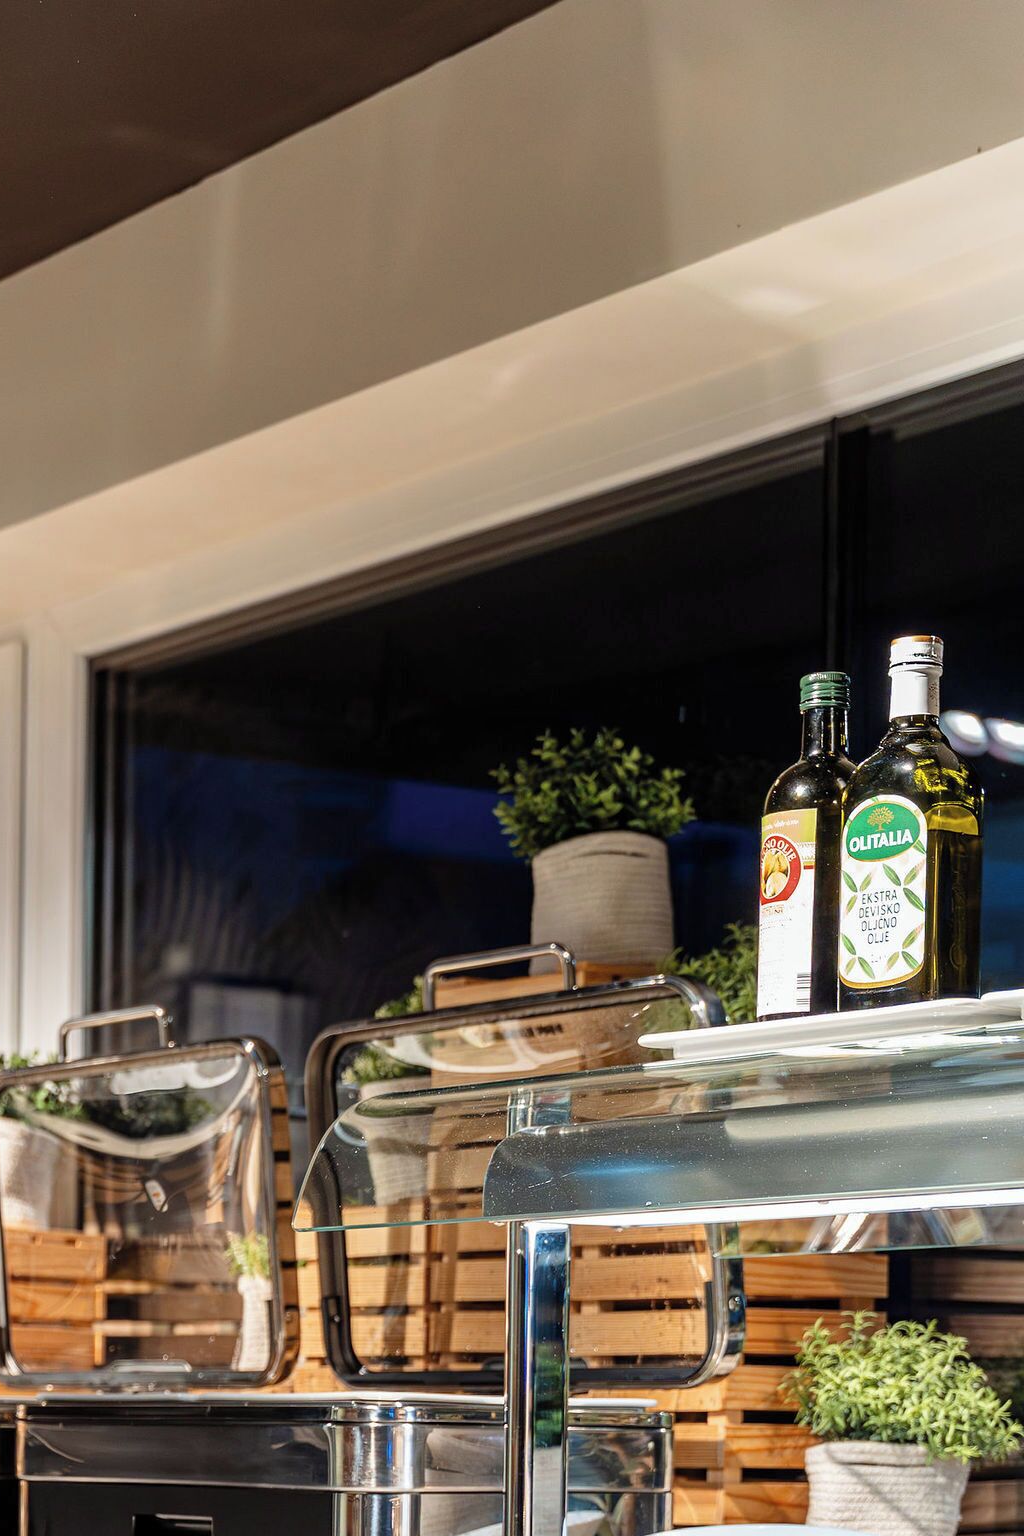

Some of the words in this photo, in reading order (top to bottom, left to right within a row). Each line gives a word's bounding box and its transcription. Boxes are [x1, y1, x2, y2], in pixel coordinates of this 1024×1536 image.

[849, 829, 914, 852] OLITALIA
[777, 840, 797, 862] OLJE
[862, 889, 898, 905] EKSTRA
[867, 931, 890, 944] OLJE
